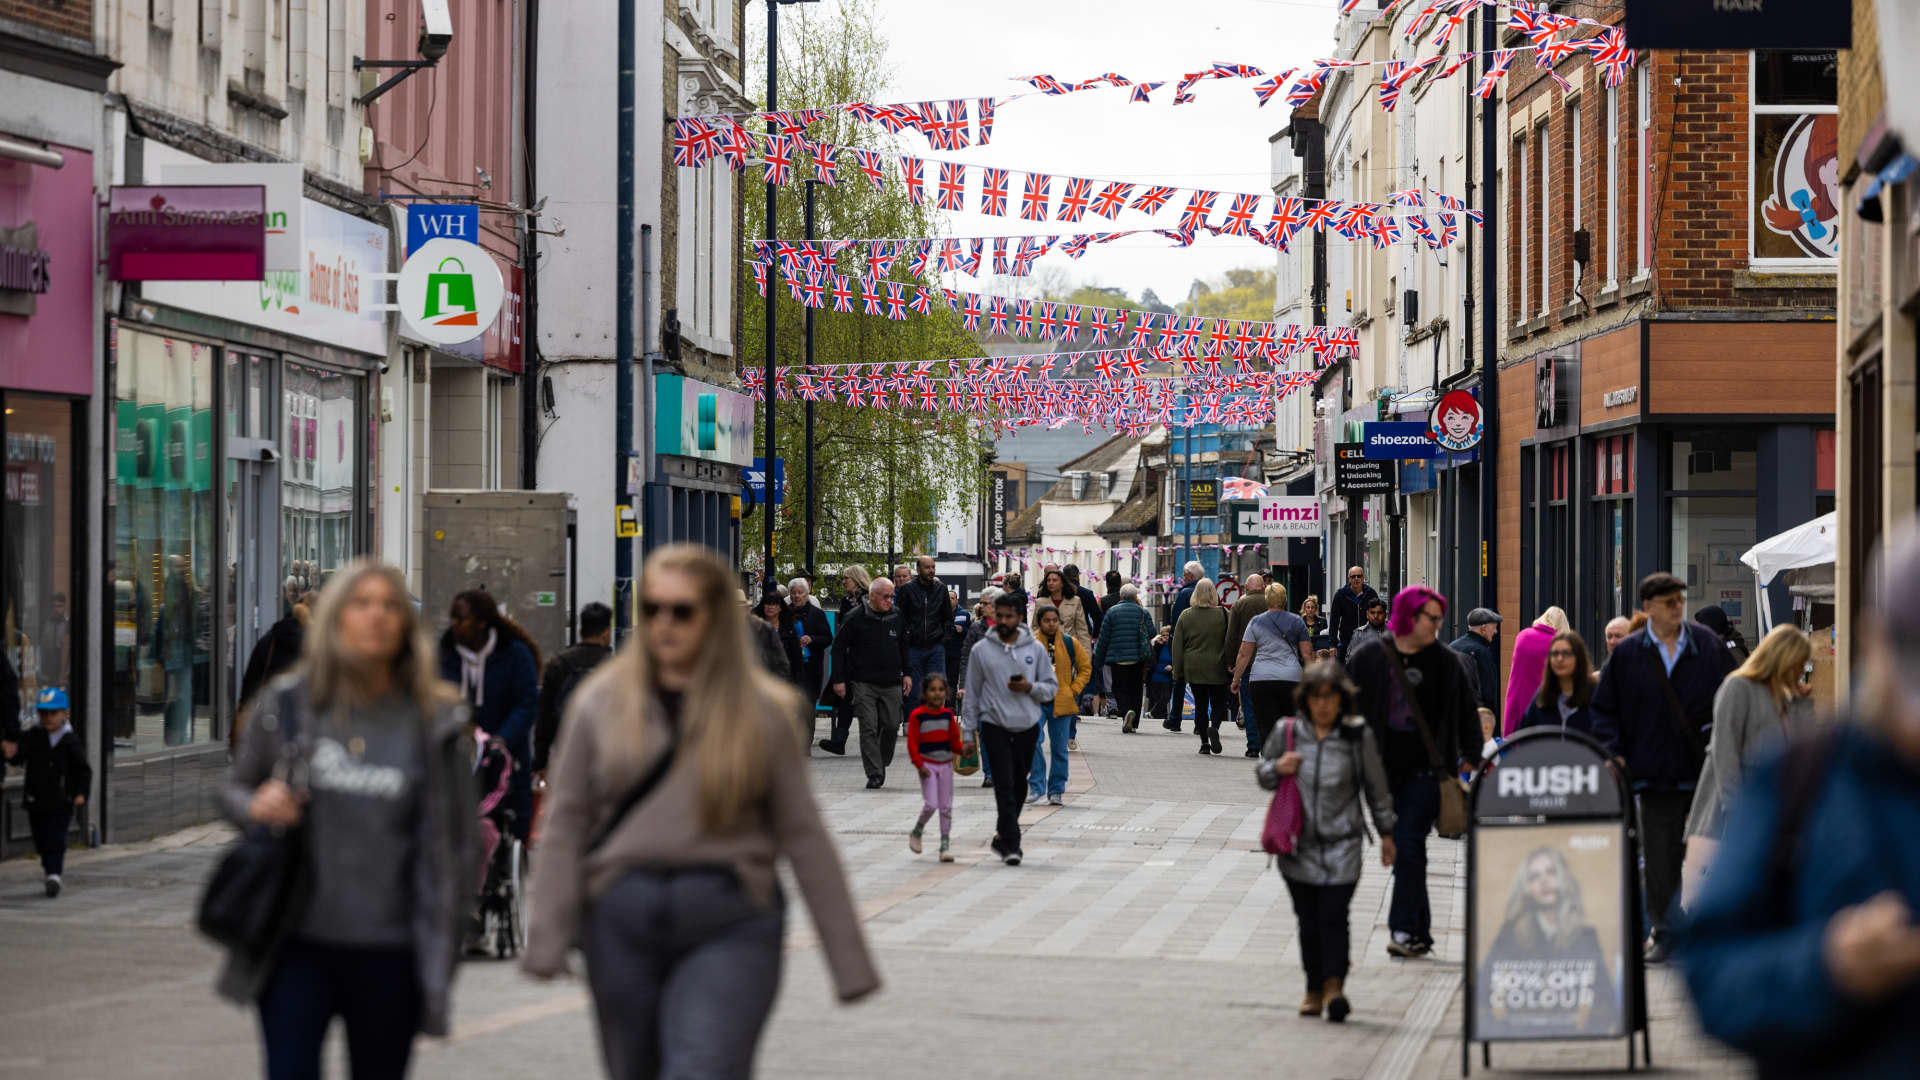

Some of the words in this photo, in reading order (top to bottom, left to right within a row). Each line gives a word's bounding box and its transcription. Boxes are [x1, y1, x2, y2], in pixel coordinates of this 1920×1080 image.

[115, 206, 158, 225] Ann
[163, 206, 259, 226] Summers
[418, 214, 467, 236] WH
[309, 250, 331, 307] Home
[333, 255, 341, 309] of
[343, 261, 359, 315] Asia
[1371, 433, 1432, 445] shoezone
[1346, 462, 1380, 471] Repairing
[1346, 472, 1382, 481] Unlocking
[1347, 481, 1389, 489] Accessories
[994, 478, 1004, 511] DOCTOR
[1262, 502, 1319, 521] rimzi
[994, 513, 1003, 545] LAPTOP
[1263, 522, 1281, 530] HAIR
[1283, 522, 1288, 530] &
[1290, 522, 1319, 530] BEAUTY
[1498, 765, 1599, 797] RUSH
